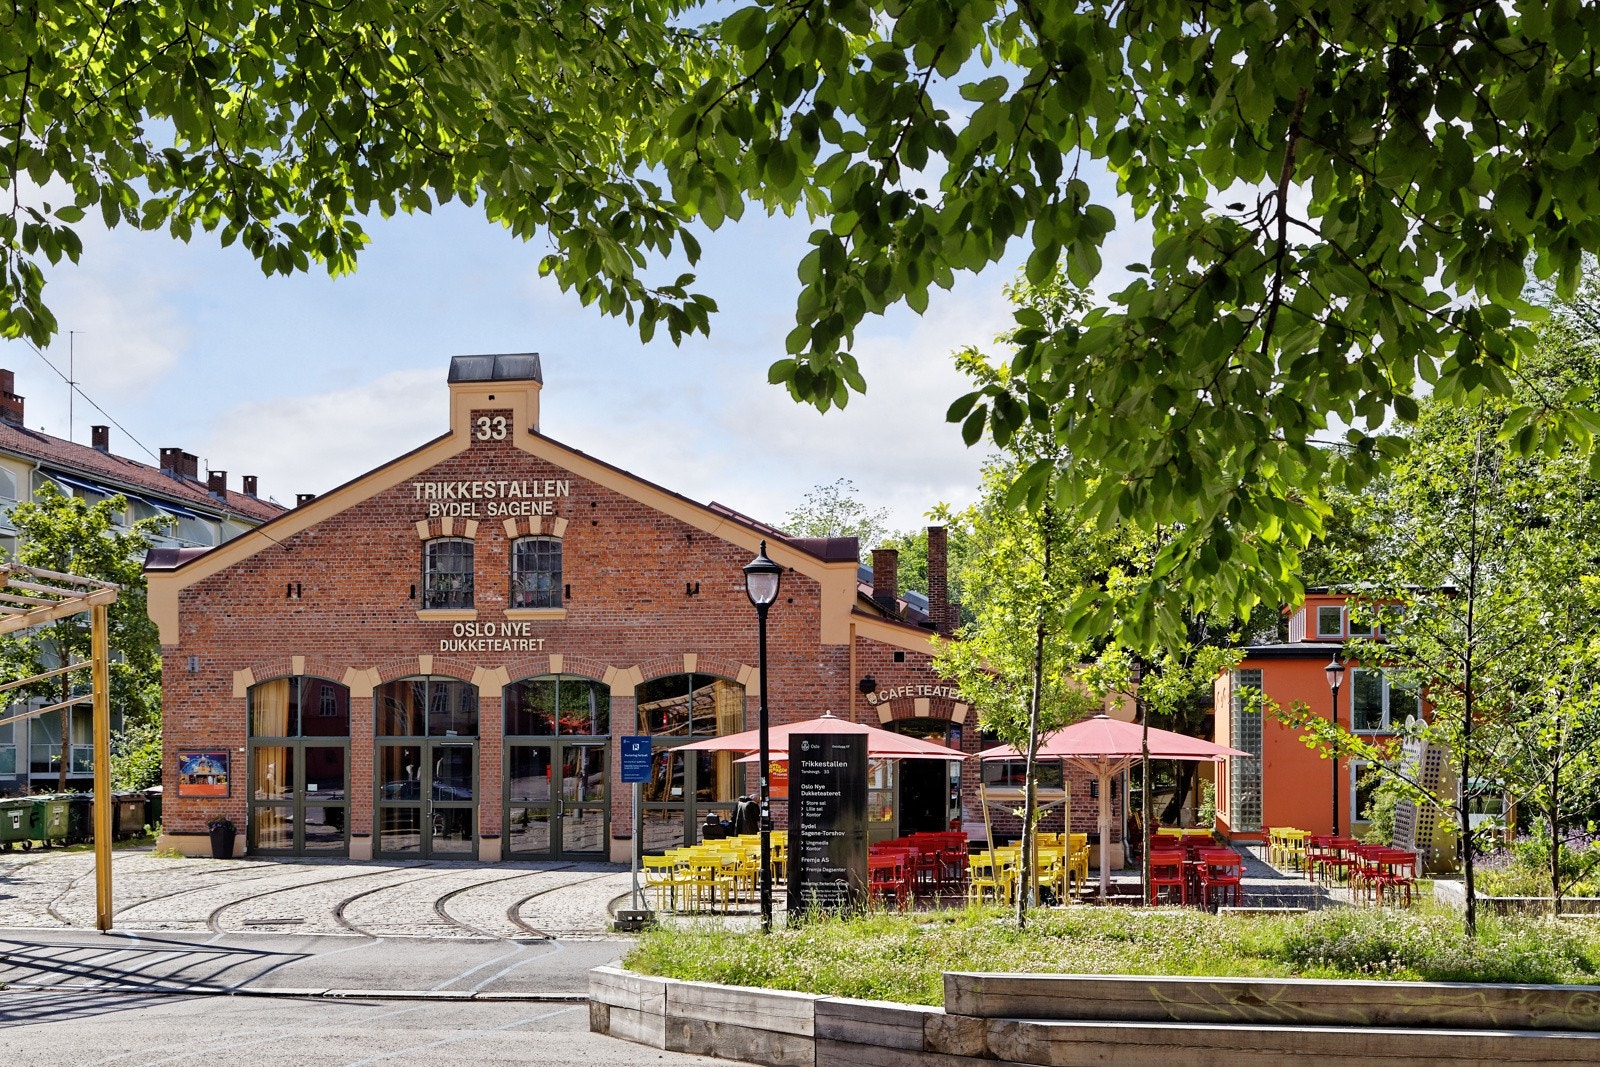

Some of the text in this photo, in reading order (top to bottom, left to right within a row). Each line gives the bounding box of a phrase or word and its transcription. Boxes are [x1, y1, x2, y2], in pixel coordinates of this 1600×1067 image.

[476, 416, 508, 441] 33
[412, 479, 570, 500] TRIKKESTALLEN
[429, 501, 553, 517] BYDEL SAGENE
[452, 622, 532, 638] OSLO NYE
[440, 638, 545, 652] DUKKETEATRET
[879, 683, 962, 701] CAFÉ TEATE
[814, 783, 826, 791] Nye
